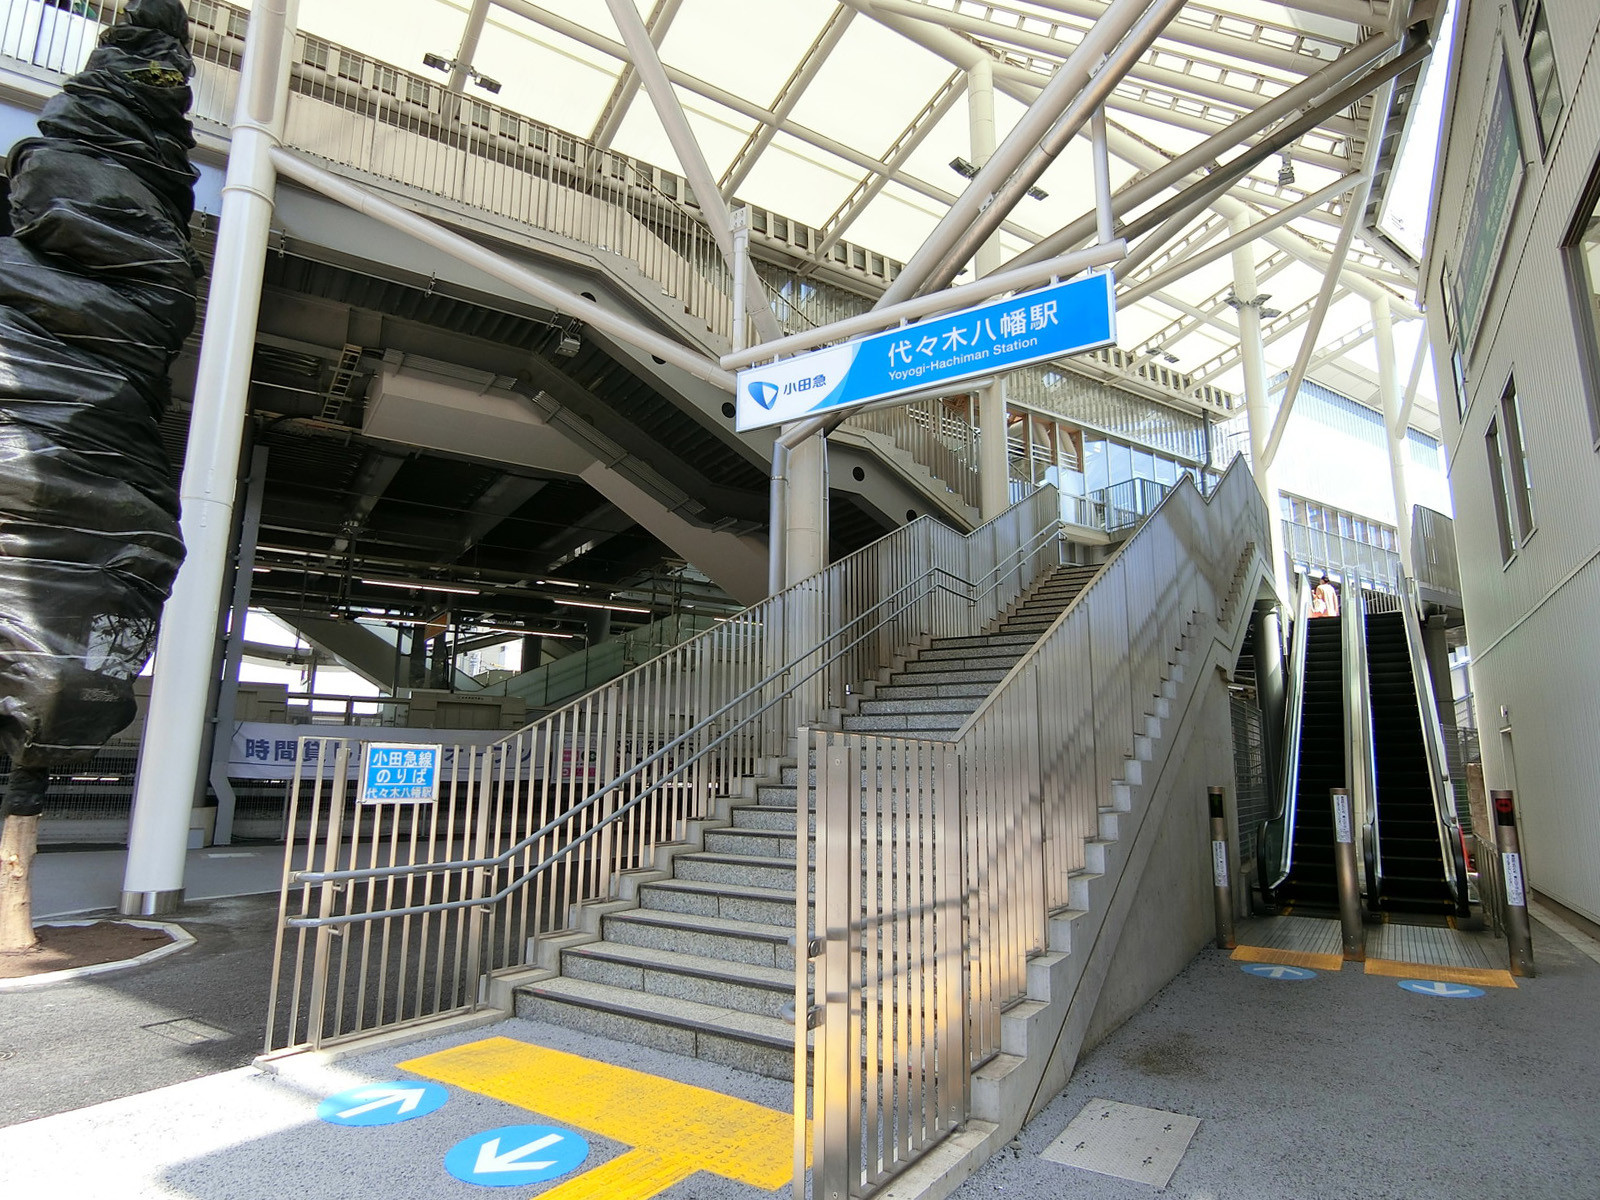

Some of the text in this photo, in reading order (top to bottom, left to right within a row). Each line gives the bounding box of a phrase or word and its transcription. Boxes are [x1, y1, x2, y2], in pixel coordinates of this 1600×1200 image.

[888, 300, 1059, 368] 代々木八幡駅
[888, 336, 1038, 381] Yoyogi-Hachiman Station
[783, 374, 827, 396] 小田急
[372, 750, 432, 767] 小田急線
[376, 768, 428, 785] のりば
[366, 786, 433, 800] 代々木八幡駅
